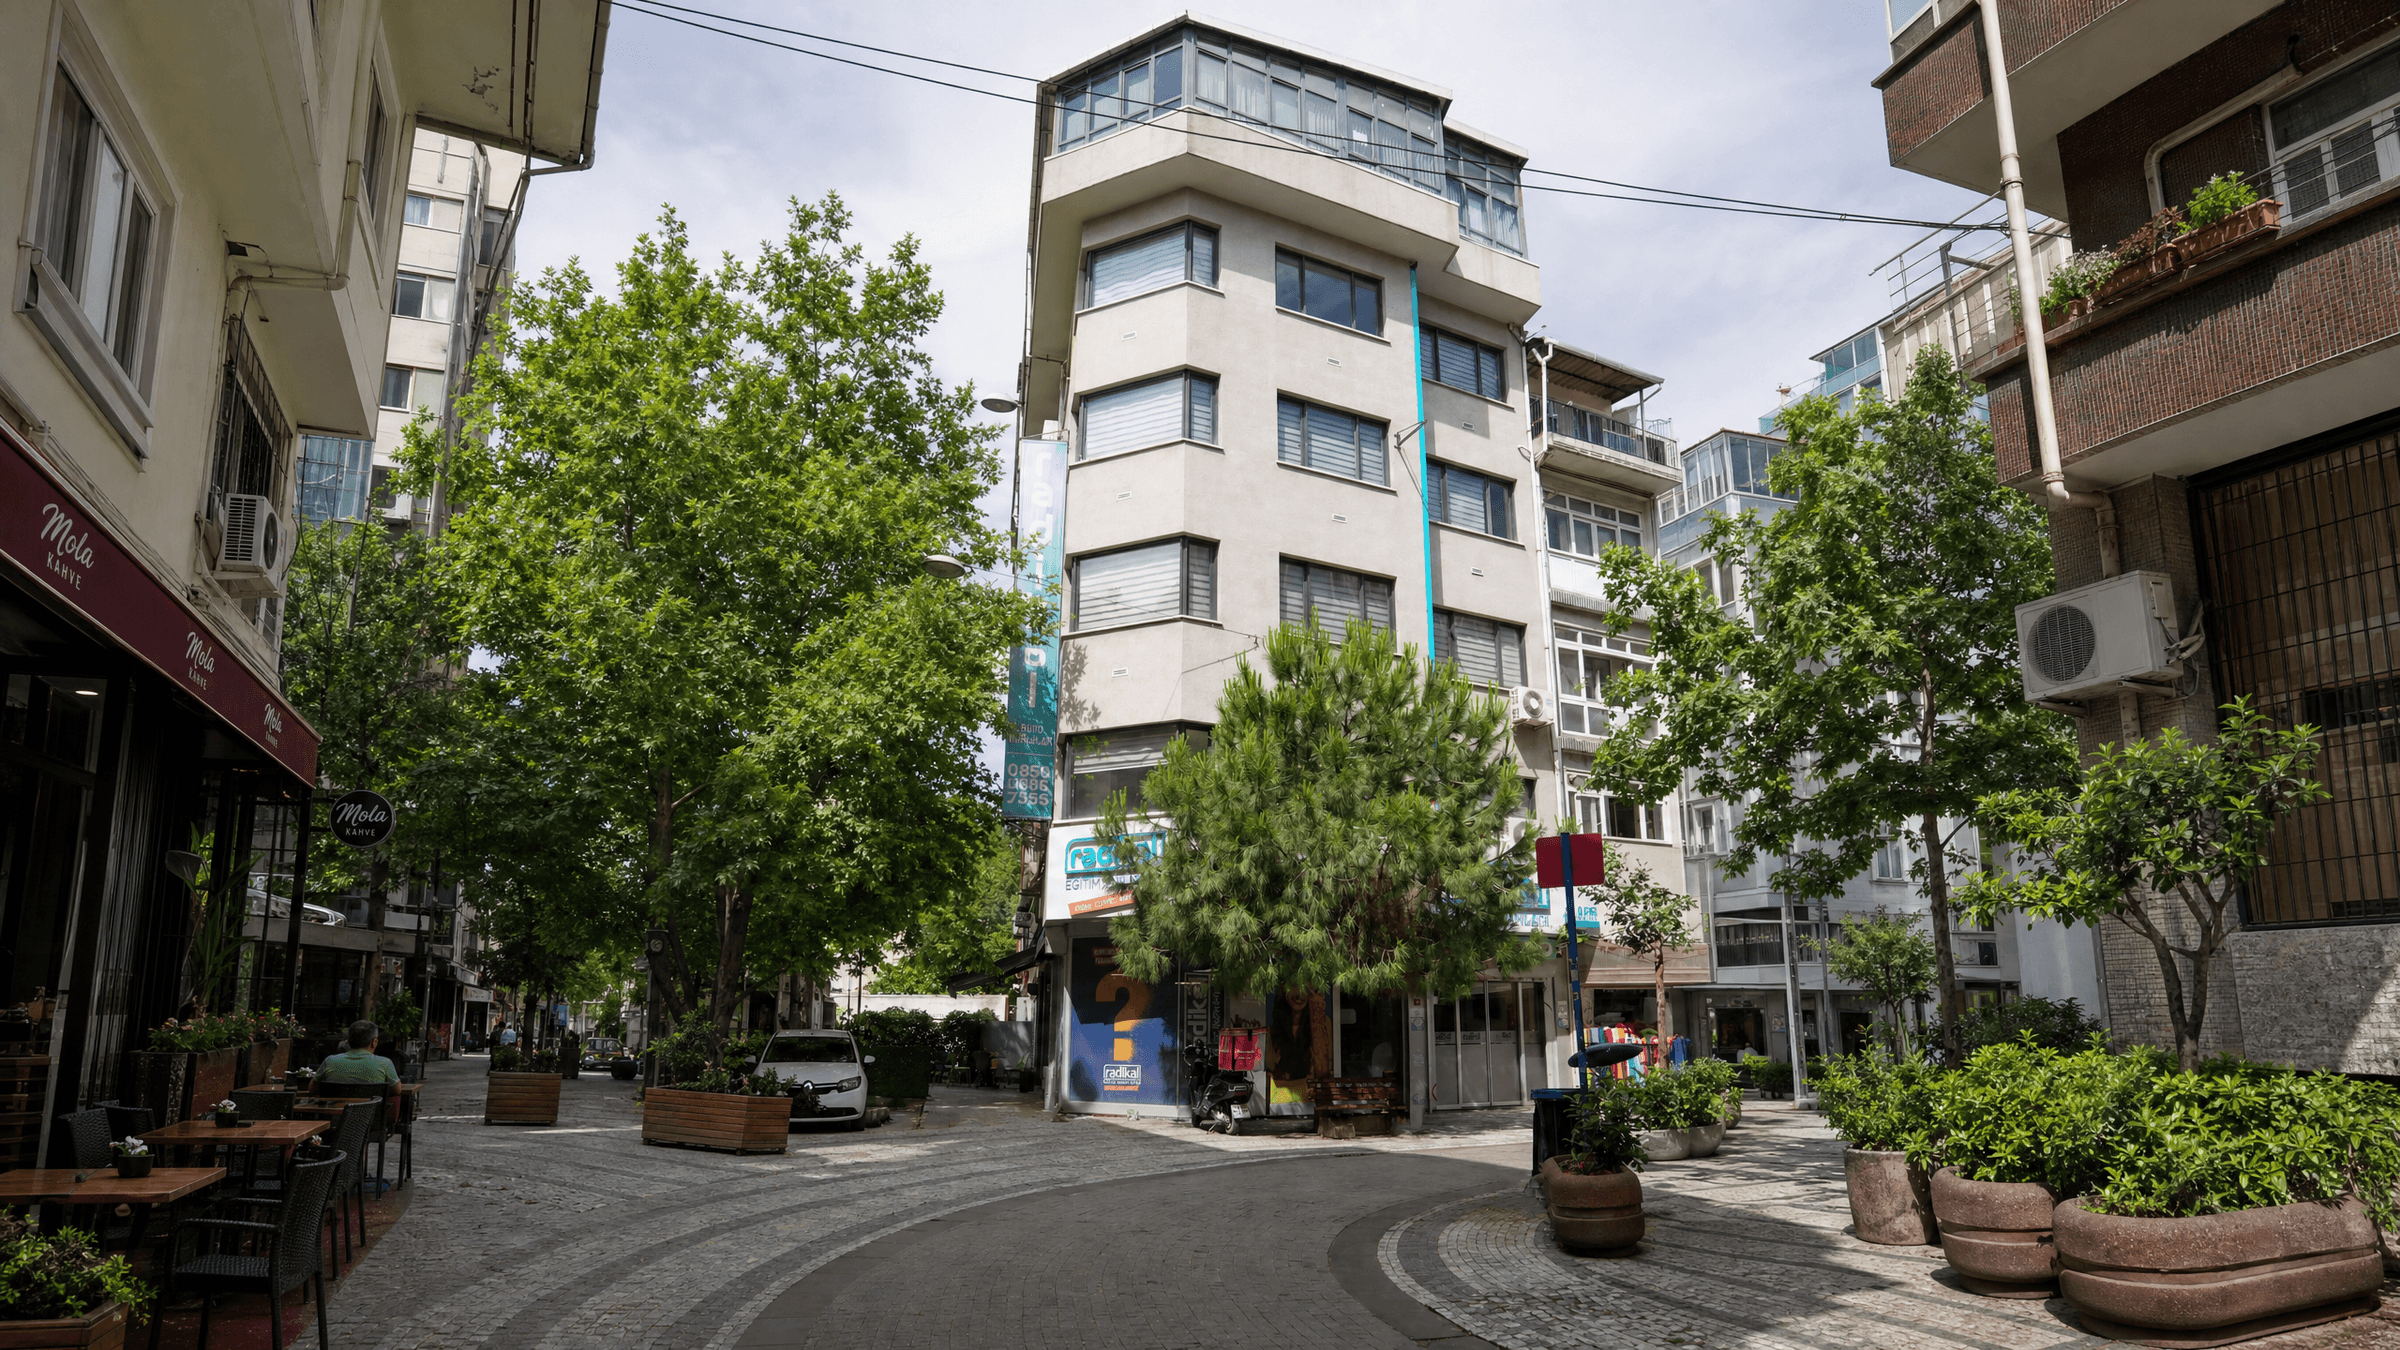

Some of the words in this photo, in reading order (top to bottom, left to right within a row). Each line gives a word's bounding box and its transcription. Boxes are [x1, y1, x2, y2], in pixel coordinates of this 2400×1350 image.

[41, 503, 94, 569] Mola
[46, 551, 81, 590] KAHVE
[186, 631, 215, 673] Mola
[264, 703, 282, 733] Mola
[336, 802, 389, 827] Mola
[345, 828, 376, 837] KAHVE
[1105, 1065, 1139, 1079] radikal
